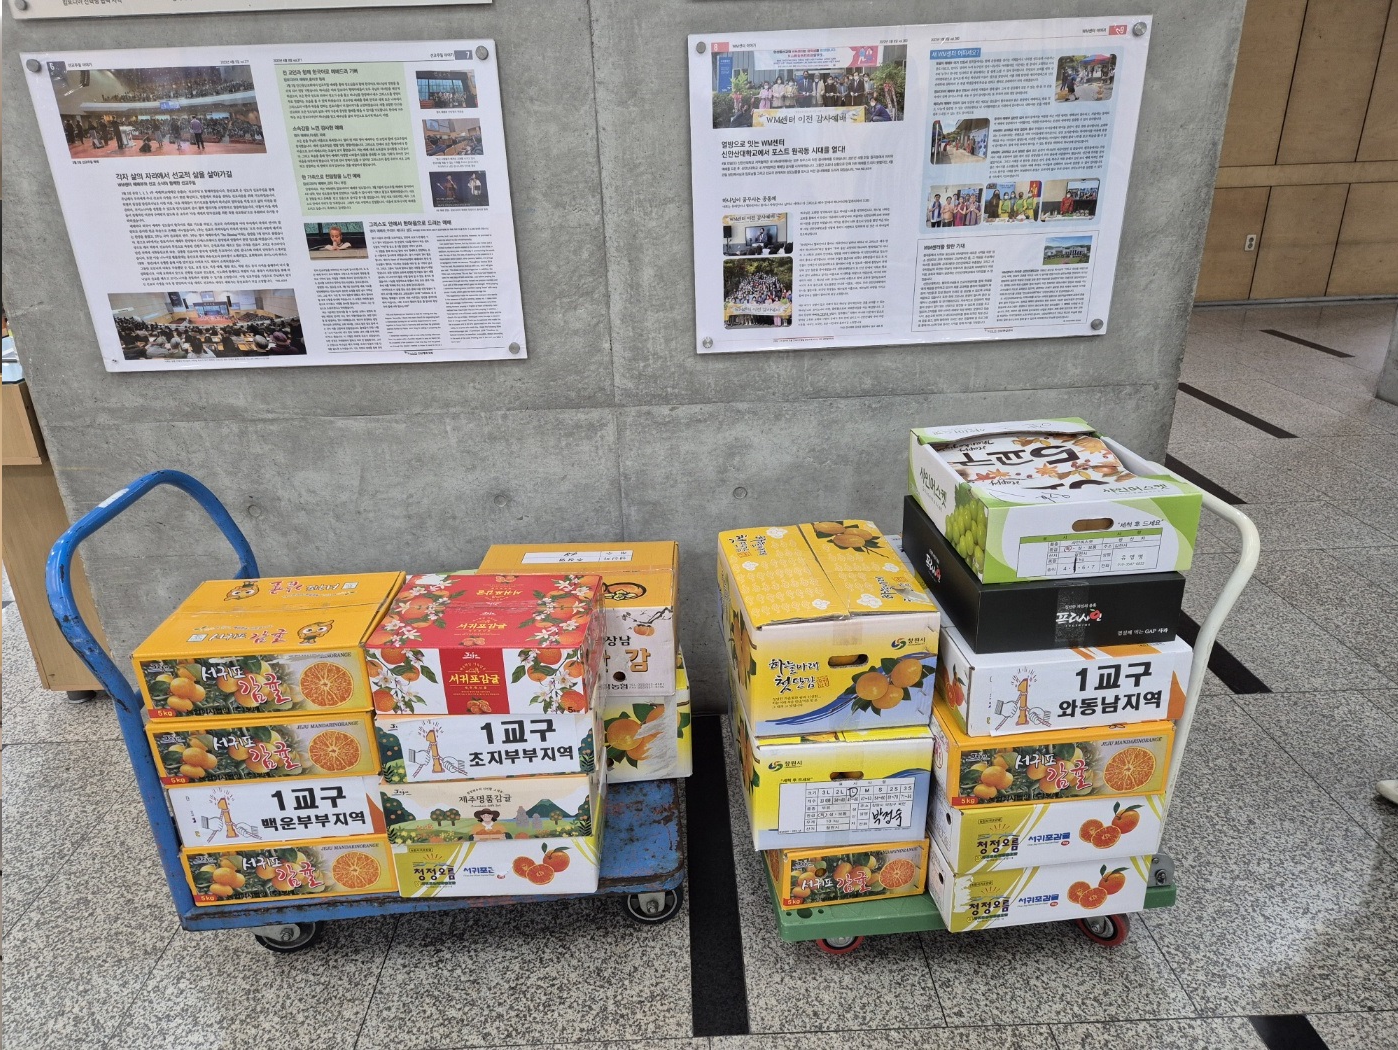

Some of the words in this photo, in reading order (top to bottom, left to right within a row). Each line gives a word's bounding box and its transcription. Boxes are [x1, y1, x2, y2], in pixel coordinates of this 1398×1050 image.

[766, 115, 796, 125] WM센터
[798, 115, 813, 123] 이전
[816, 113, 847, 123] 감사예배
[721, 140, 746, 149] 열방으로
[747, 139, 760, 148] 잇는
[761, 138, 785, 147] WM센터
[721, 149, 770, 159] 신안산대학교에서
[771, 148, 790, 157] 포스트
[791, 147, 809, 156] 원곡동
[811, 146, 830, 155] 시대를
[831, 145, 846, 155] 열다!
[115, 173, 128, 181] 각자
[131, 172, 143, 181] 삶의
[145, 172, 170, 180] 자리에서
[172, 171, 191, 179] 선교적
[192, 171, 205, 179] 삶을
[207, 170, 233, 179] 살아가길
[456, 622, 508, 630] 서귀포감귤
[250, 629, 289, 644] 감귤
[605, 635, 631, 646] 상남
[625, 647, 651, 673] 감
[201, 666, 247, 682] 서귀포
[448, 673, 501, 685] 서귀포감귤
[238, 673, 292, 705] 감귤
[1057, 690, 1164, 719] 와동남지역
[310, 720, 359, 729] MANDARINORANGE
[213, 736, 257, 751] 서귀포
[1114, 737, 1163, 746] MANDARINORANGE
[250, 741, 302, 771] 감귤
[469, 745, 575, 768] 초지부부지역
[1015, 753, 1057, 769] 서귀포
[1047, 759, 1093, 790] 감귤
[458, 793, 513, 804] 제주명품감귤
[261, 811, 367, 832] 백운부부지역
[1028, 832, 1071, 843] 서귀포감귤
[334, 842, 380, 851] MANDARINORANGE
[977, 837, 1019, 855] 청정오름
[242, 856, 283, 871] 서귀포
[276, 861, 325, 889] 감귤
[413, 867, 456, 882] 청정오름
[837, 871, 872, 893] 감귤
[801, 878, 834, 891] 서귀포
[1018, 893, 1060, 904] 서귀포감귤
[969, 899, 1010, 916] 청정오름
